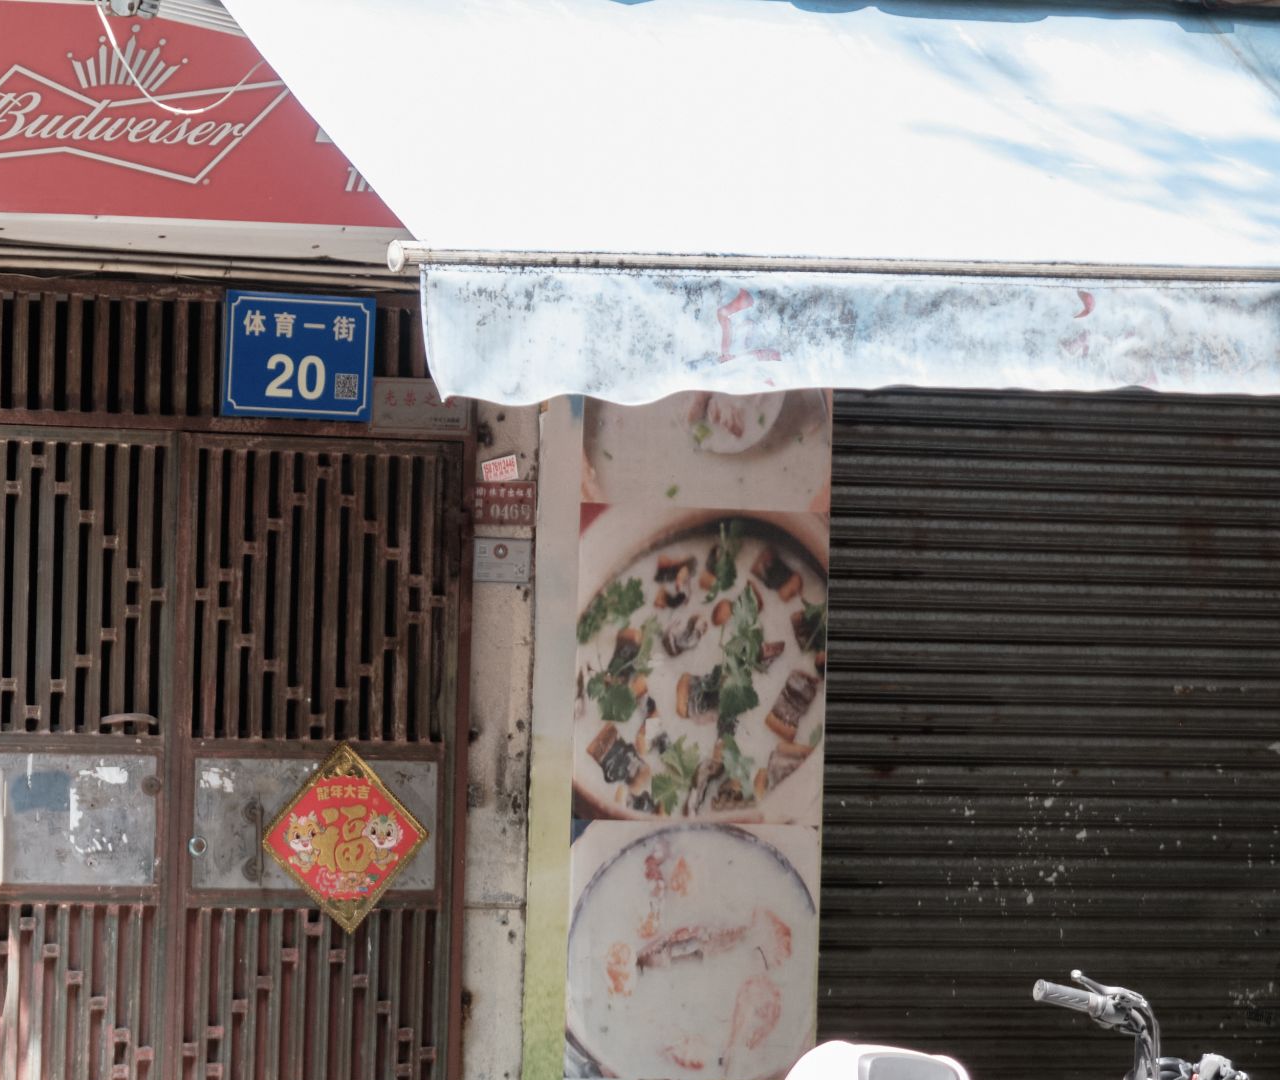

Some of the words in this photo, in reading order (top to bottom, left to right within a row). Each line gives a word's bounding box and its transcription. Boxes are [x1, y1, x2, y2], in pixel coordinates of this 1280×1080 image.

[243, 310, 356, 342] 体育一街
[265, 353, 326, 400] 20
[316, 785, 371, 801] 龍年大吉
[312, 804, 377, 873] 福
